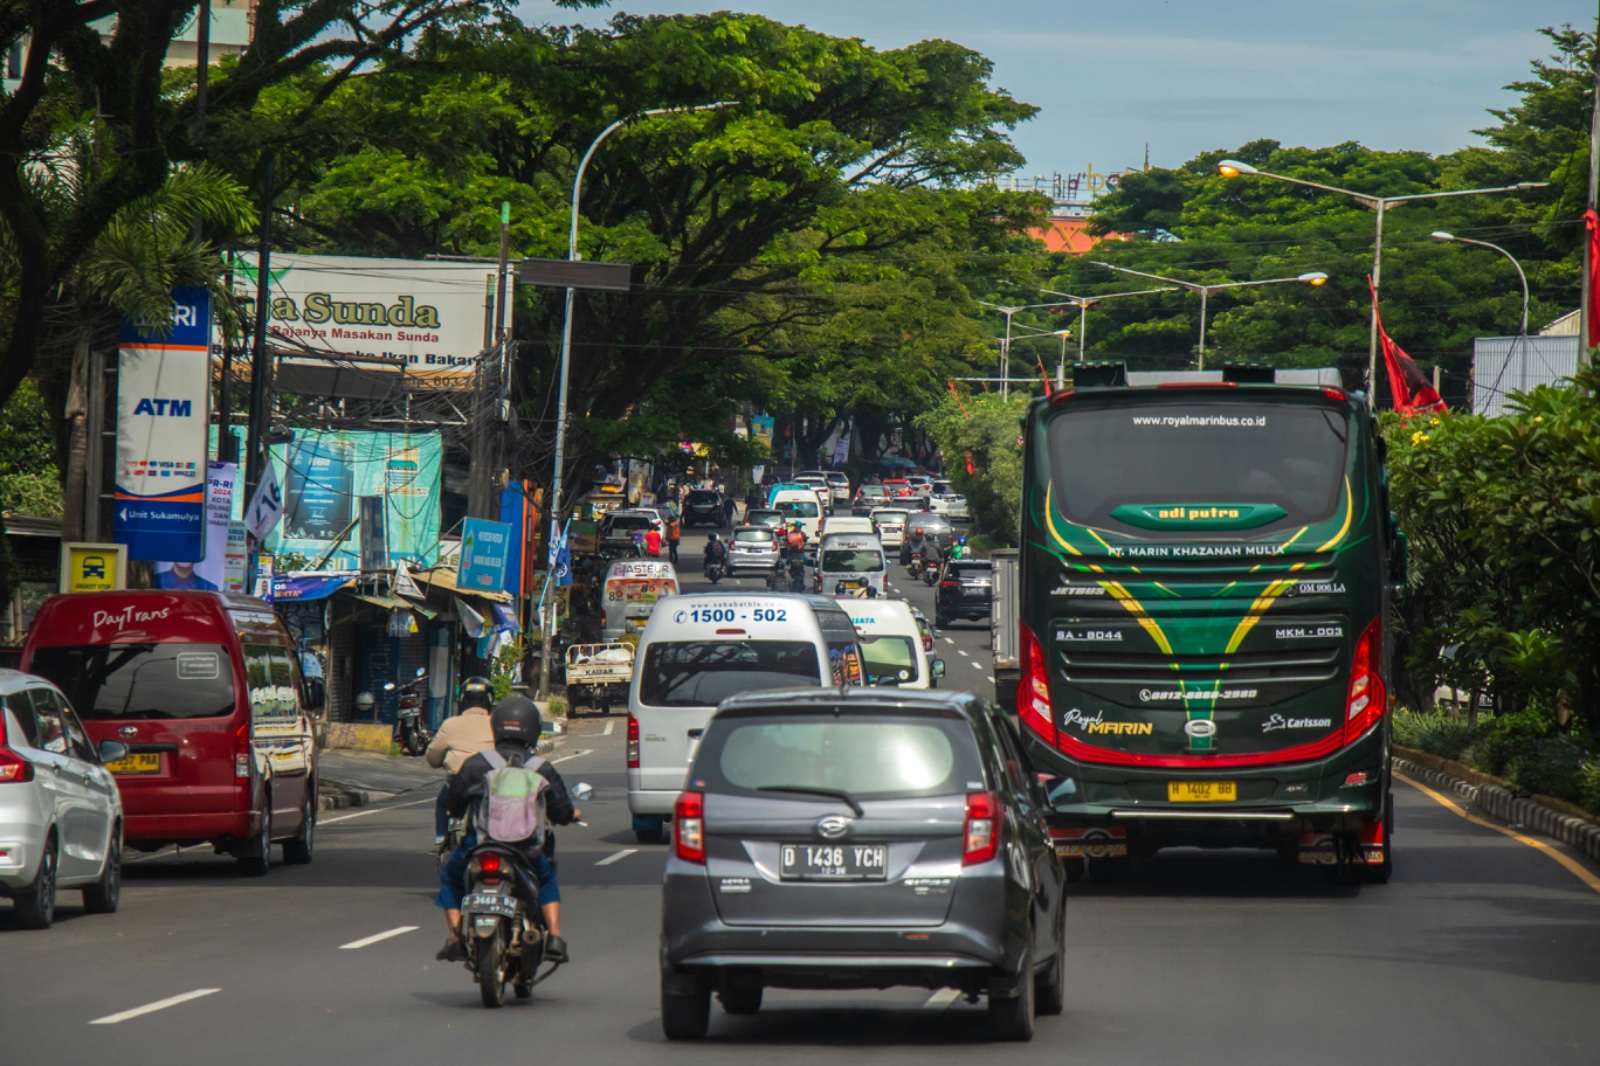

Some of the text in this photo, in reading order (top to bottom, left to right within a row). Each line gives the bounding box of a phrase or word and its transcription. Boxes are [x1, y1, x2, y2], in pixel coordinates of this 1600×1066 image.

[304, 292, 441, 329] Sunda
[271, 325, 439, 343] Rajanya Masakan Sunda
[133, 398, 191, 417] ATM
[1133, 415, 1266, 427] www.royalmarinbus.co.id
[213, 488, 231, 496] 2024
[128, 510, 200, 521] Unit Sukamulya
[1158, 507, 1239, 520] adi putra
[1108, 545, 1285, 556] PT. MARIN KHAZANAH MULIA
[613, 563, 669, 576] PASTEUR
[1050, 587, 1106, 595] JETBUS
[1300, 583, 1314, 592] OM
[1333, 583, 1346, 592] LA
[93, 605, 170, 630] DayTrans
[690, 609, 735, 622] 1500
[753, 609, 787, 622] 502
[1086, 631, 1122, 640] 8044
[1275, 628, 1305, 638] MKM
[1064, 708, 1103, 730] Royal
[1287, 718, 1332, 728] Carlsson
[1088, 722, 1153, 735] MARIN
[1187, 782, 1211, 794] 1402
[784, 848, 883, 867] D 1436 YCH
